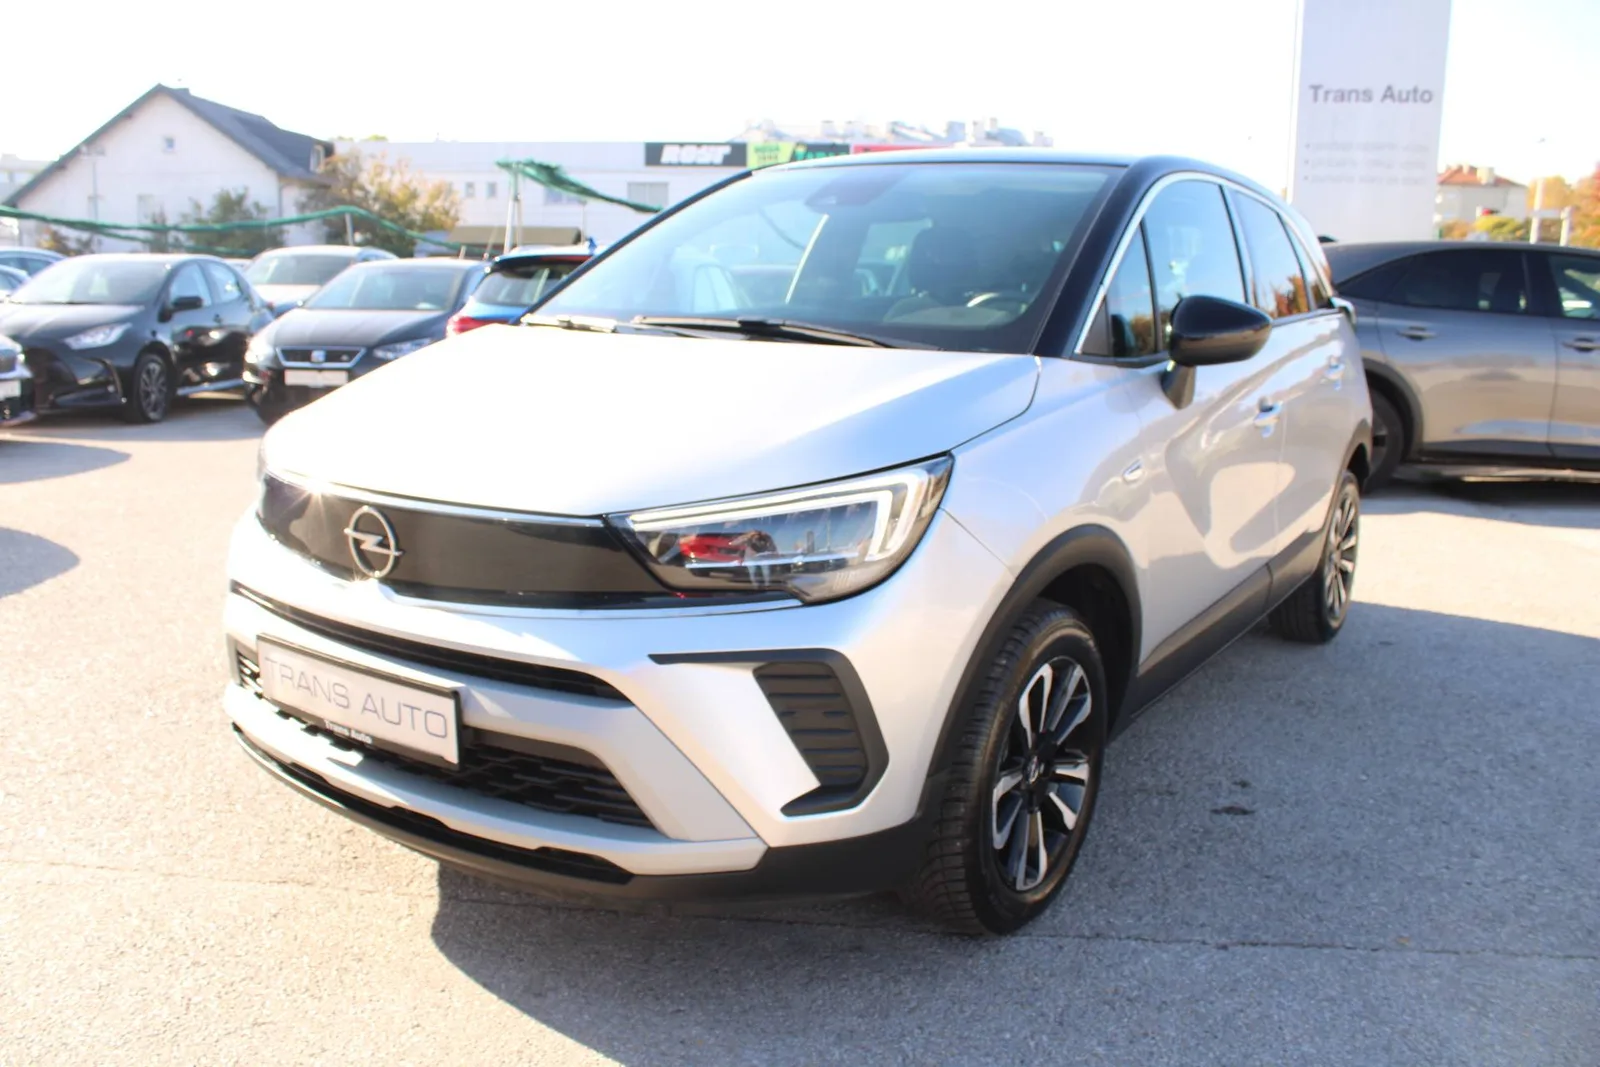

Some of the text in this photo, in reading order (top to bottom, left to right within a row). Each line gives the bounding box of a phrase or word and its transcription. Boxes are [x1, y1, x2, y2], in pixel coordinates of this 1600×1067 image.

[1309, 84, 1434, 104] Trans Auto
[264, 656, 448, 739] TRANS AUTO
